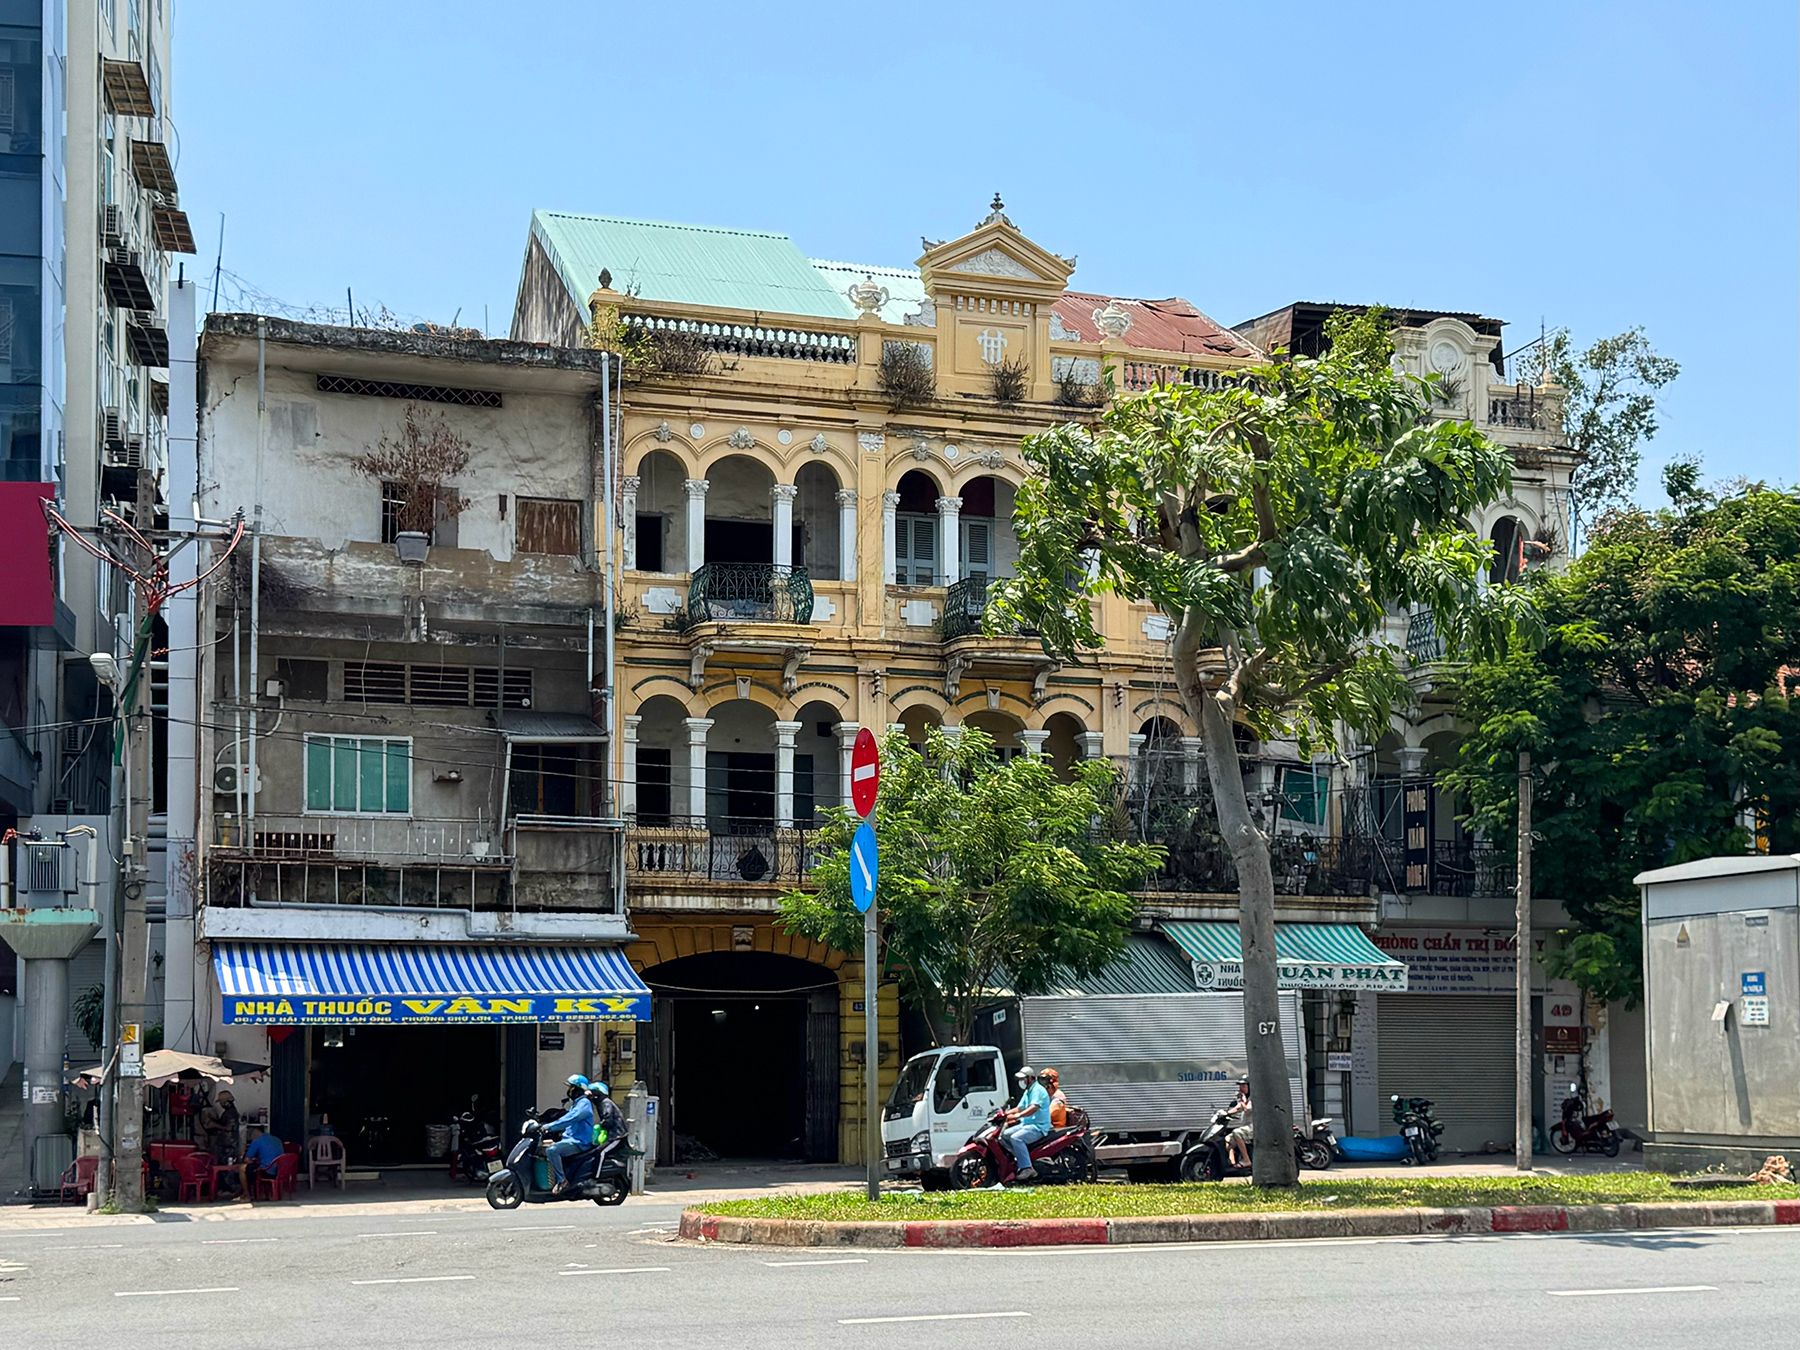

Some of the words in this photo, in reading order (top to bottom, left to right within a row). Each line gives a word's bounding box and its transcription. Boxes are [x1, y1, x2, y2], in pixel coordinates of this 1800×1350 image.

[1466, 938, 1489, 954] TRỊ
[1536, 940, 1545, 951] Y
[235, 998, 295, 1015] NHÀ
[303, 996, 393, 1015] THUỐC
[401, 996, 535, 1014] VÂN
[1551, 1004, 1572, 1017] 49
[1258, 1021, 1276, 1035] G7
